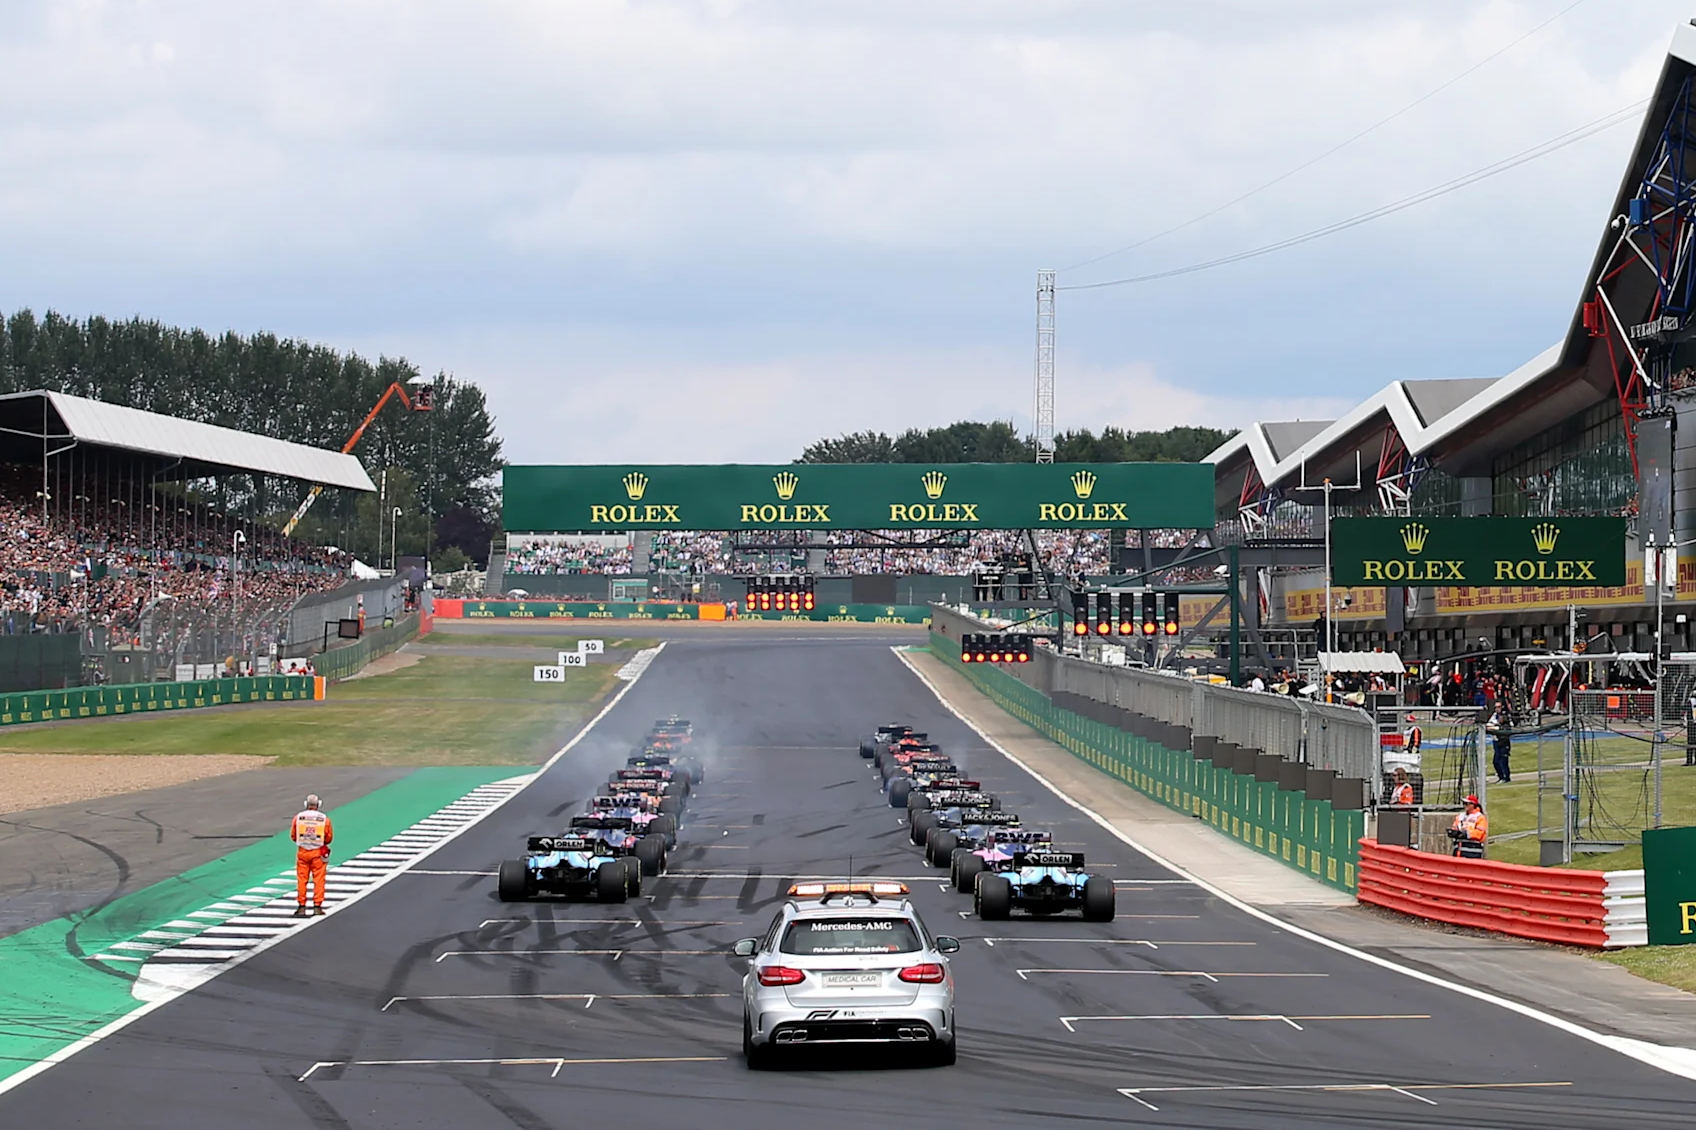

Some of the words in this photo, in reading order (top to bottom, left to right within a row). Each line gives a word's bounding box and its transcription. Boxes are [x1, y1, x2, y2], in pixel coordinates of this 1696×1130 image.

[591, 505, 680, 522] ROLEX
[741, 505, 830, 522] ROLEX
[889, 504, 979, 521] ROLEX
[1039, 503, 1129, 520] ROLEX
[1363, 561, 1465, 580] ROLEX
[1494, 560, 1596, 580] ROLEX
[585, 643, 597, 651] 50
[563, 655, 580, 664] 100
[539, 669, 558, 679] 150
[1042, 855, 1070, 863] ORLEN
[811, 922, 893, 931] Mercedes-AMG
